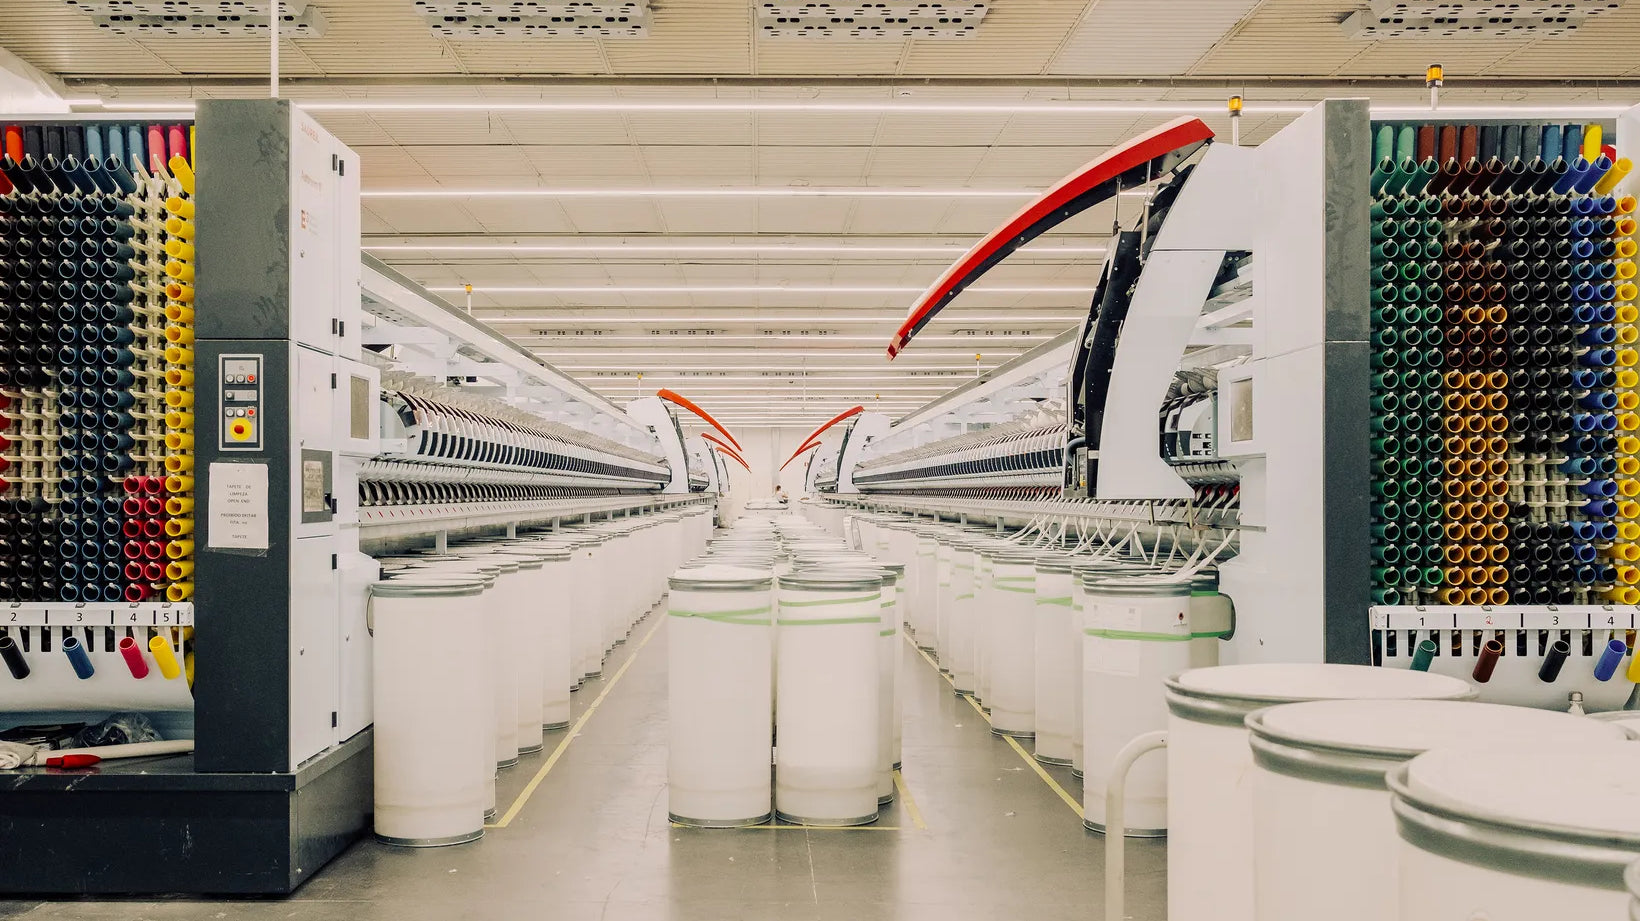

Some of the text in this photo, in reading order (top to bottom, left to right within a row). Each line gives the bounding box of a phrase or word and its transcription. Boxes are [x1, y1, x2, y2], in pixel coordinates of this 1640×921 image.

[10, 612, 17, 622] 2
[76, 612, 83, 622] 3
[129, 612, 137, 622] 4
[163, 612, 170, 622] 5
[1419, 617, 1424, 626] 1
[1485, 615, 1493, 625] 2
[1552, 616, 1559, 625] 3
[1607, 616, 1614, 625] 4
